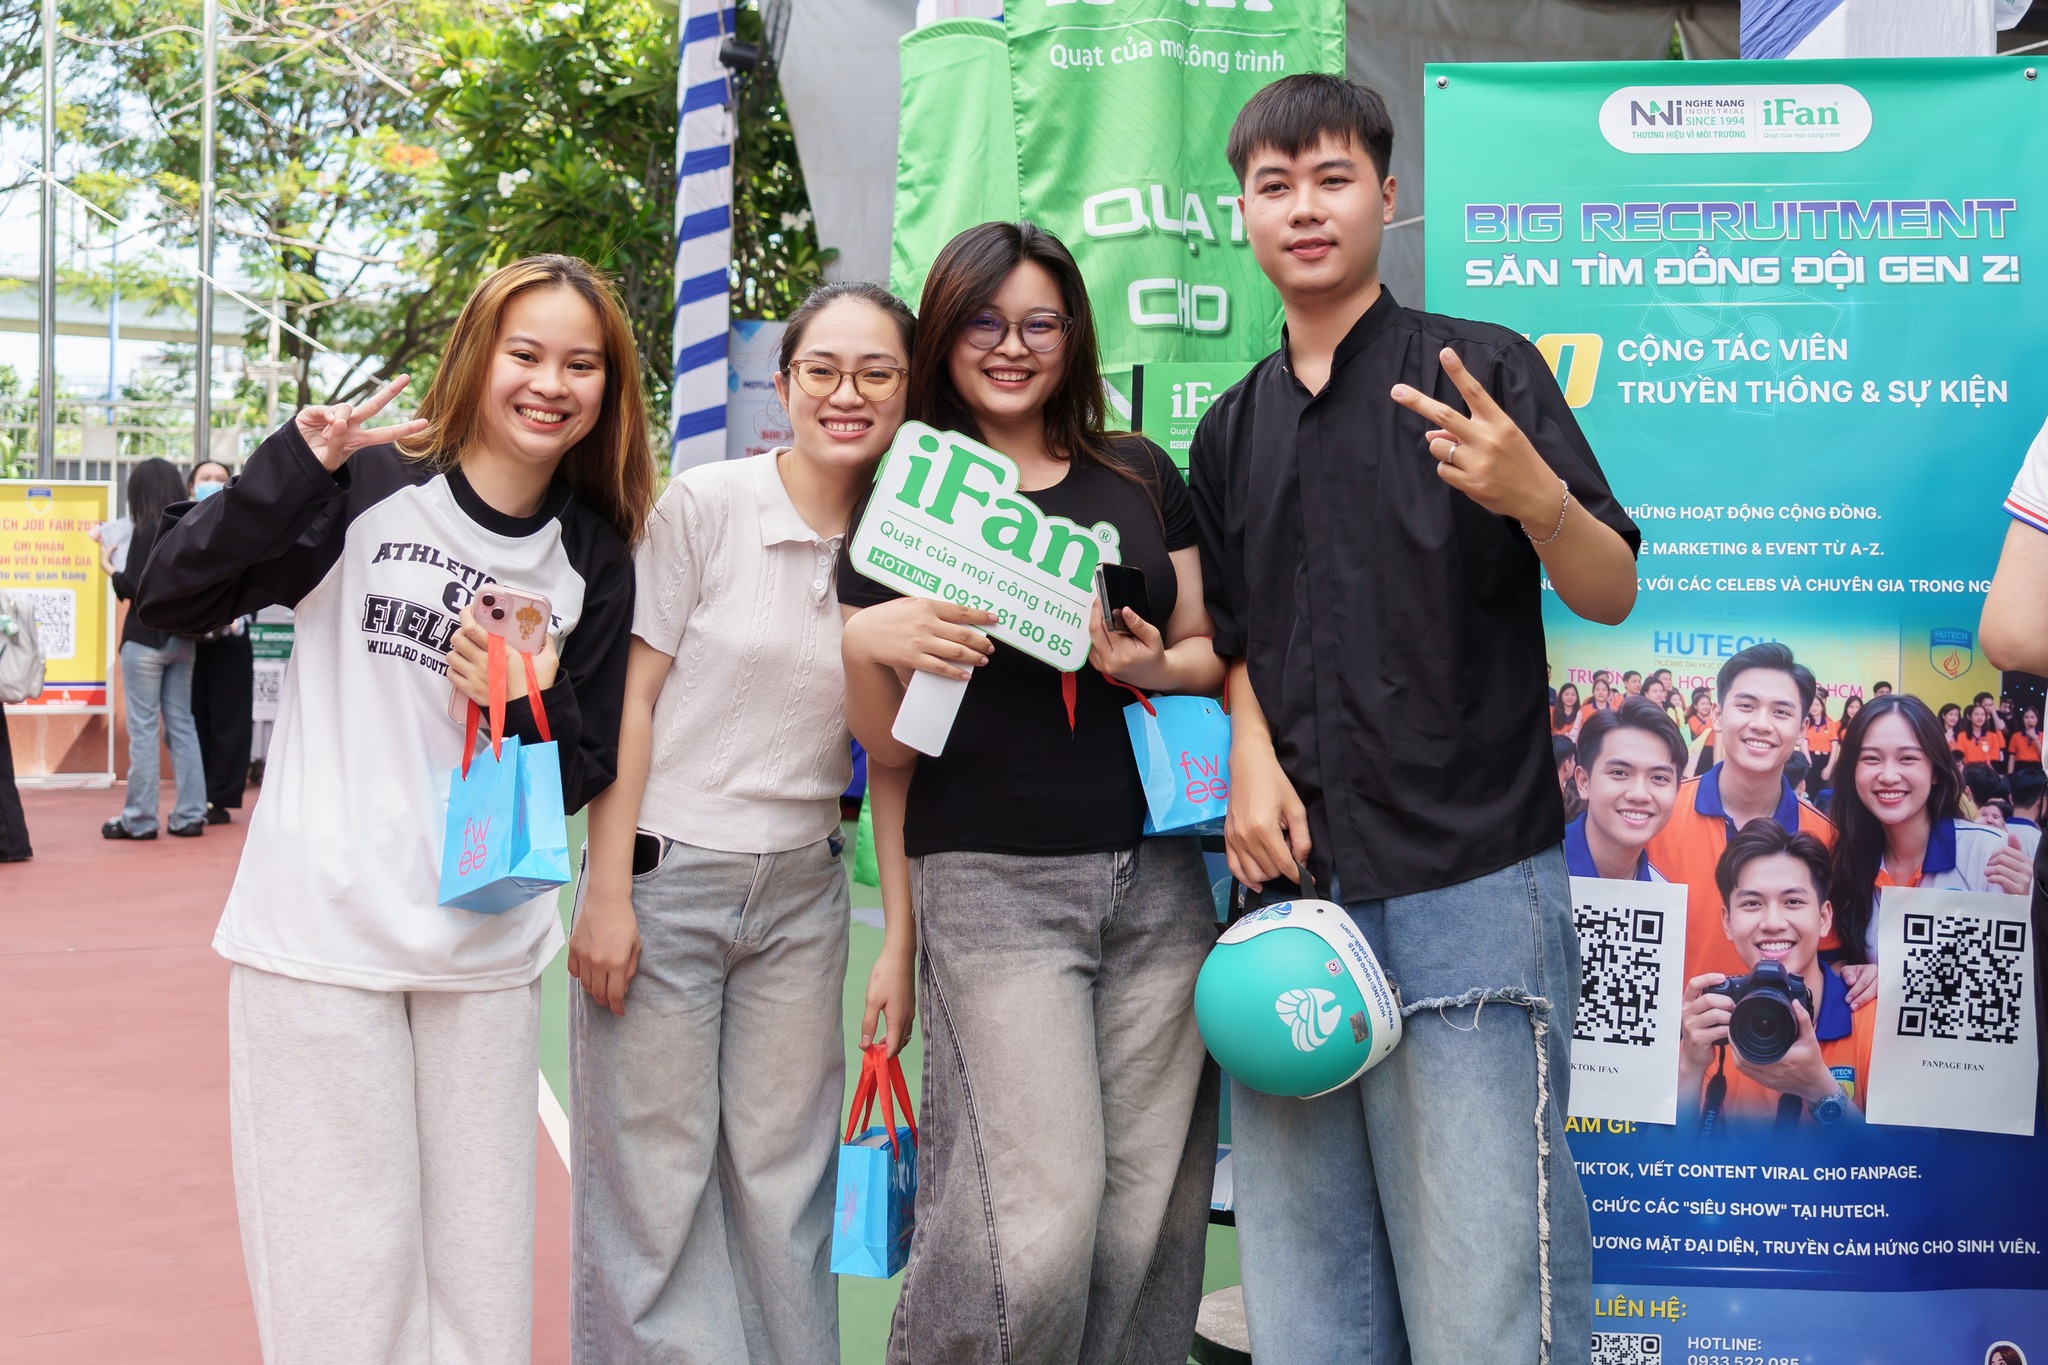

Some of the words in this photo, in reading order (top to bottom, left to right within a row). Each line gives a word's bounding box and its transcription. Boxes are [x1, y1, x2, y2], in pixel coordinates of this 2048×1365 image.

[1050, 44, 1104, 72] Quạt
[1111, 36, 1153, 64] của
[1160, 39, 1184, 65] mọi
[1235, 45, 1285, 72] trình
[1685, 99, 1712, 108] NGHE
[1716, 99, 1745, 107] NANG
[1685, 116, 1716, 126] SINCE
[1720, 116, 1745, 126] 1994
[1632, 129, 1663, 139] THƯƠNG
[1666, 129, 1685, 141] HIỆU
[1687, 128, 1695, 139] VÌ
[1697, 128, 1711, 138] MÔI
[1713, 128, 1746, 139] TRƯỜNG
[1083, 184, 1244, 251] QUẠT
[1465, 203, 1562, 242] BIG
[1581, 199, 2016, 242] RECRUITMENT
[1465, 253, 1558, 286] SĂN
[1572, 252, 1643, 286] TÌM
[1654, 245, 1780, 286] ĐỒNG
[1791, 249, 1865, 291] ĐỘI
[1879, 256, 1969, 283] GEN
[1982, 255, 2020, 284] Z!
[1127, 278, 1227, 331] CHO
[1617, 333, 1704, 367] CỘNG
[1712, 333, 1771, 361] TÁC
[1778, 332, 1848, 361] VIÊN
[1171, 381, 1222, 418] iF
[1618, 374, 1737, 404] TRUYỀN
[1745, 374, 1853, 404] THÔNG
[1861, 380, 1880, 403] &
[1888, 379, 1932, 409] SỰ
[1940, 373, 2008, 409] KIỆN
[1680, 506, 1724, 522] HOẠT
[1727, 503, 1775, 522] ĐỘNG
[1779, 503, 1826, 522] CỘNG
[1829, 503, 1882, 520] ĐỒNG.
[23, 519, 44, 530] JOB
[1653, 542, 1747, 555] MARKETING
[1751, 543, 1762, 555] &
[1766, 543, 1818, 555] EVENT
[1823, 540, 1846, 556] TỪ
[1850, 543, 1884, 556] A-Z.
[880, 521, 922, 551] Quạt
[926, 546, 957, 568] của
[961, 562, 995, 586] mọi
[997, 580, 1039, 610] công
[1044, 600, 1082, 629] trình
[1646, 575, 1674, 591] VỚI
[1678, 576, 1712, 591] CÁC
[1716, 578, 1776, 591] CELEBS
[1780, 575, 1802, 591] VÀ
[1806, 576, 1873, 592] CHUYÊN
[1877, 579, 1905, 592] GIA
[1909, 580, 1964, 593] TRONG
[871, 551, 938, 591] HOTLINE
[1019, 620, 1045, 643] 80
[1047, 633, 1073, 657] 85
[367, 640, 418, 662] WILLARD
[1654, 630, 1777, 657] HUTEC
[1570, 1062, 1597, 1072] KTOK
[1598, 1065, 1619, 1074] IFAN
[1922, 1060, 1962, 1070] FANPAGE
[1963, 1062, 1985, 1071] IFAN
[1638, 1160, 1674, 1177] VIẾT
[1678, 1164, 1757, 1179] CONTENT
[1761, 1166, 1809, 1180] VIRAL
[1813, 1167, 1847, 1180] CHO
[1851, 1166, 1922, 1180] FANPAGE.
[1592, 1196, 1641, 1213] CHỨC
[1645, 1198, 1680, 1214] CÁC
[1684, 1199, 1726, 1216] "SIÊU
[1730, 1203, 1787, 1217] SHOW"
[1791, 1204, 1817, 1221] TẠI
[1820, 1204, 1890, 1218] HUTECH.
[1646, 1235, 1681, 1254] MẶT
[1684, 1239, 1713, 1255] ĐẠI
[1717, 1237, 1759, 1256] DIỆN,
[1763, 1237, 1829, 1255] TRUYỀN
[1833, 1238, 1871, 1256] CẢM
[1875, 1239, 1919, 1255] HỨNG
[1922, 1241, 1954, 1254] CHO
[1957, 1240, 1995, 1254] SINH
[1998, 1238, 2041, 1255] VIÊN.
[1595, 1294, 1644, 1317] LIÊN
[1650, 1295, 1687, 1323] HỆ:
[1688, 1337, 1762, 1351] HOTLINE:
